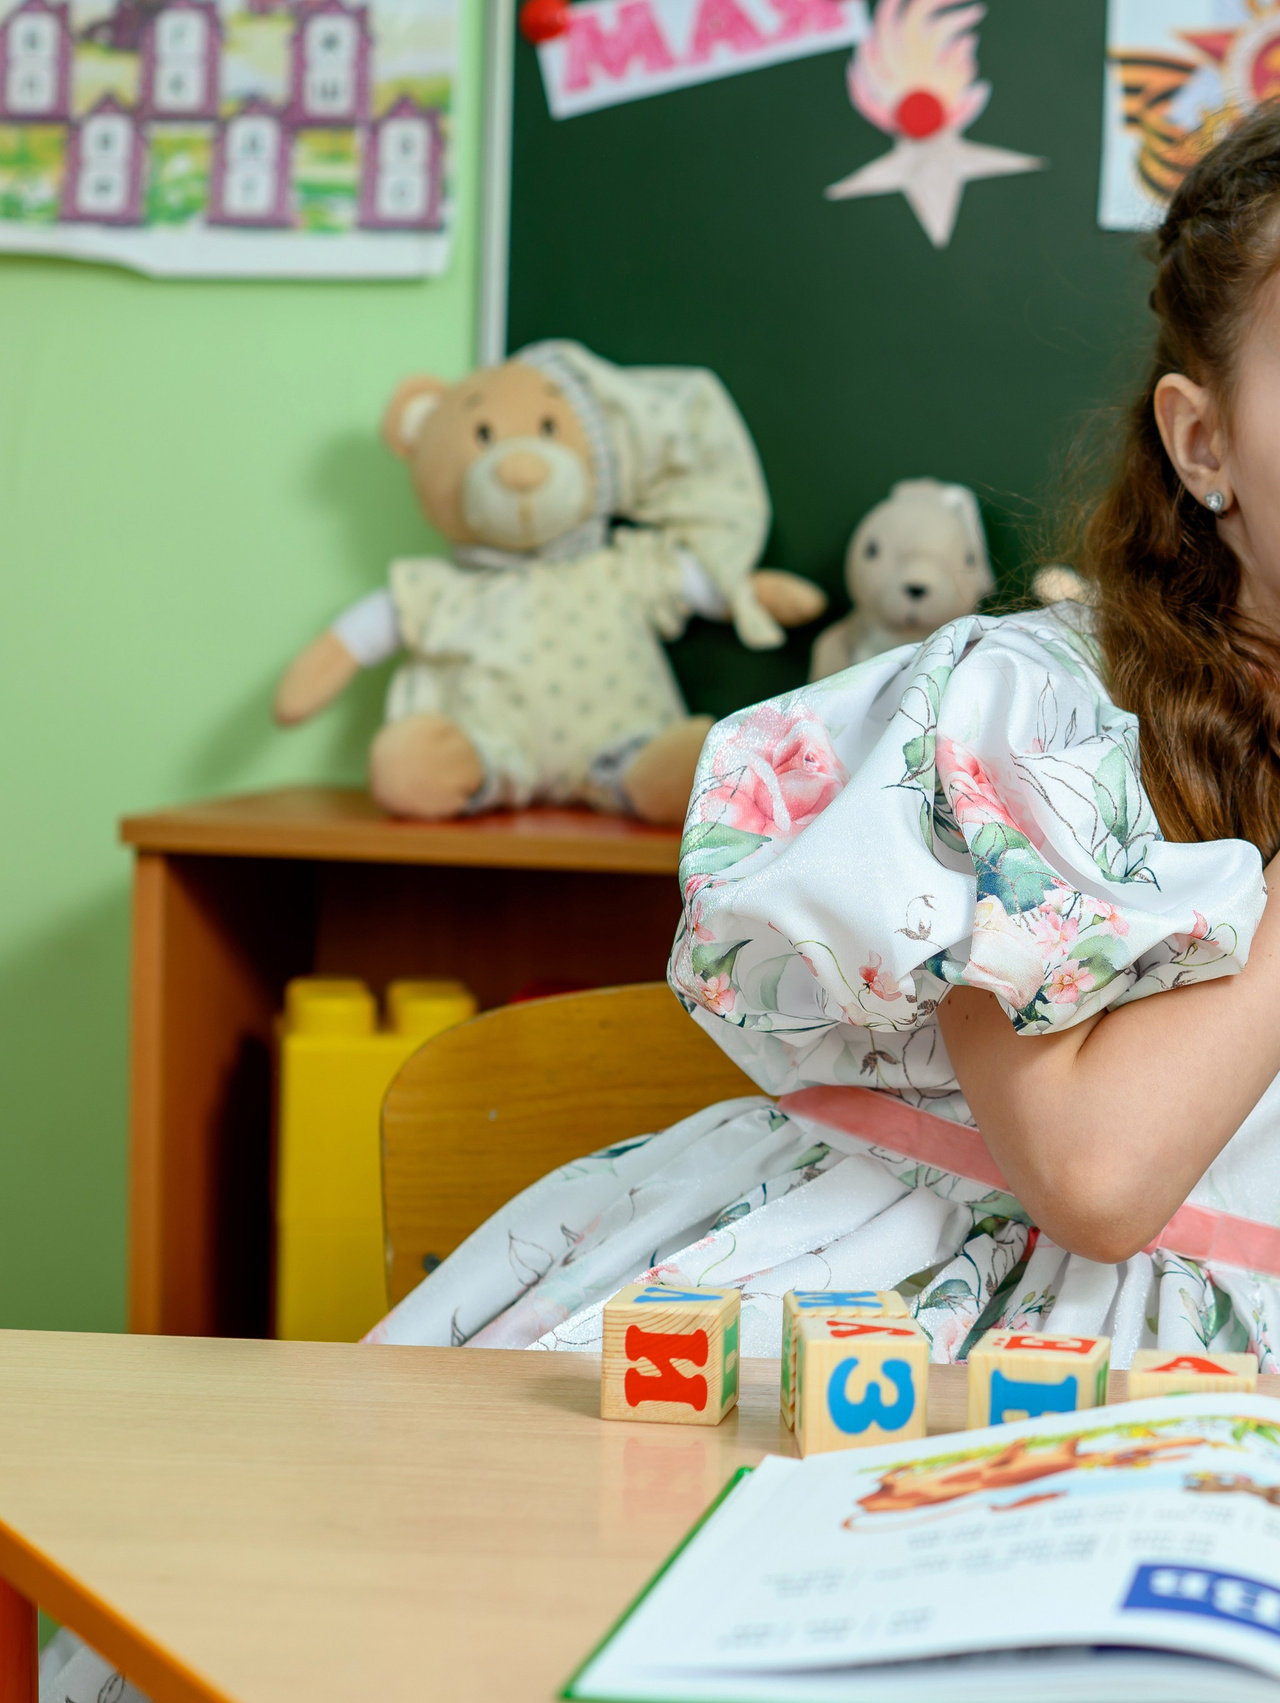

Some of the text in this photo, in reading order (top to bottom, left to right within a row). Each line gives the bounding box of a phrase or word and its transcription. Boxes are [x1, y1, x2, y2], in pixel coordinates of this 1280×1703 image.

[826, 1320, 916, 1338] У
[624, 1325, 709, 1412] И
[827, 1357, 915, 1434] З
